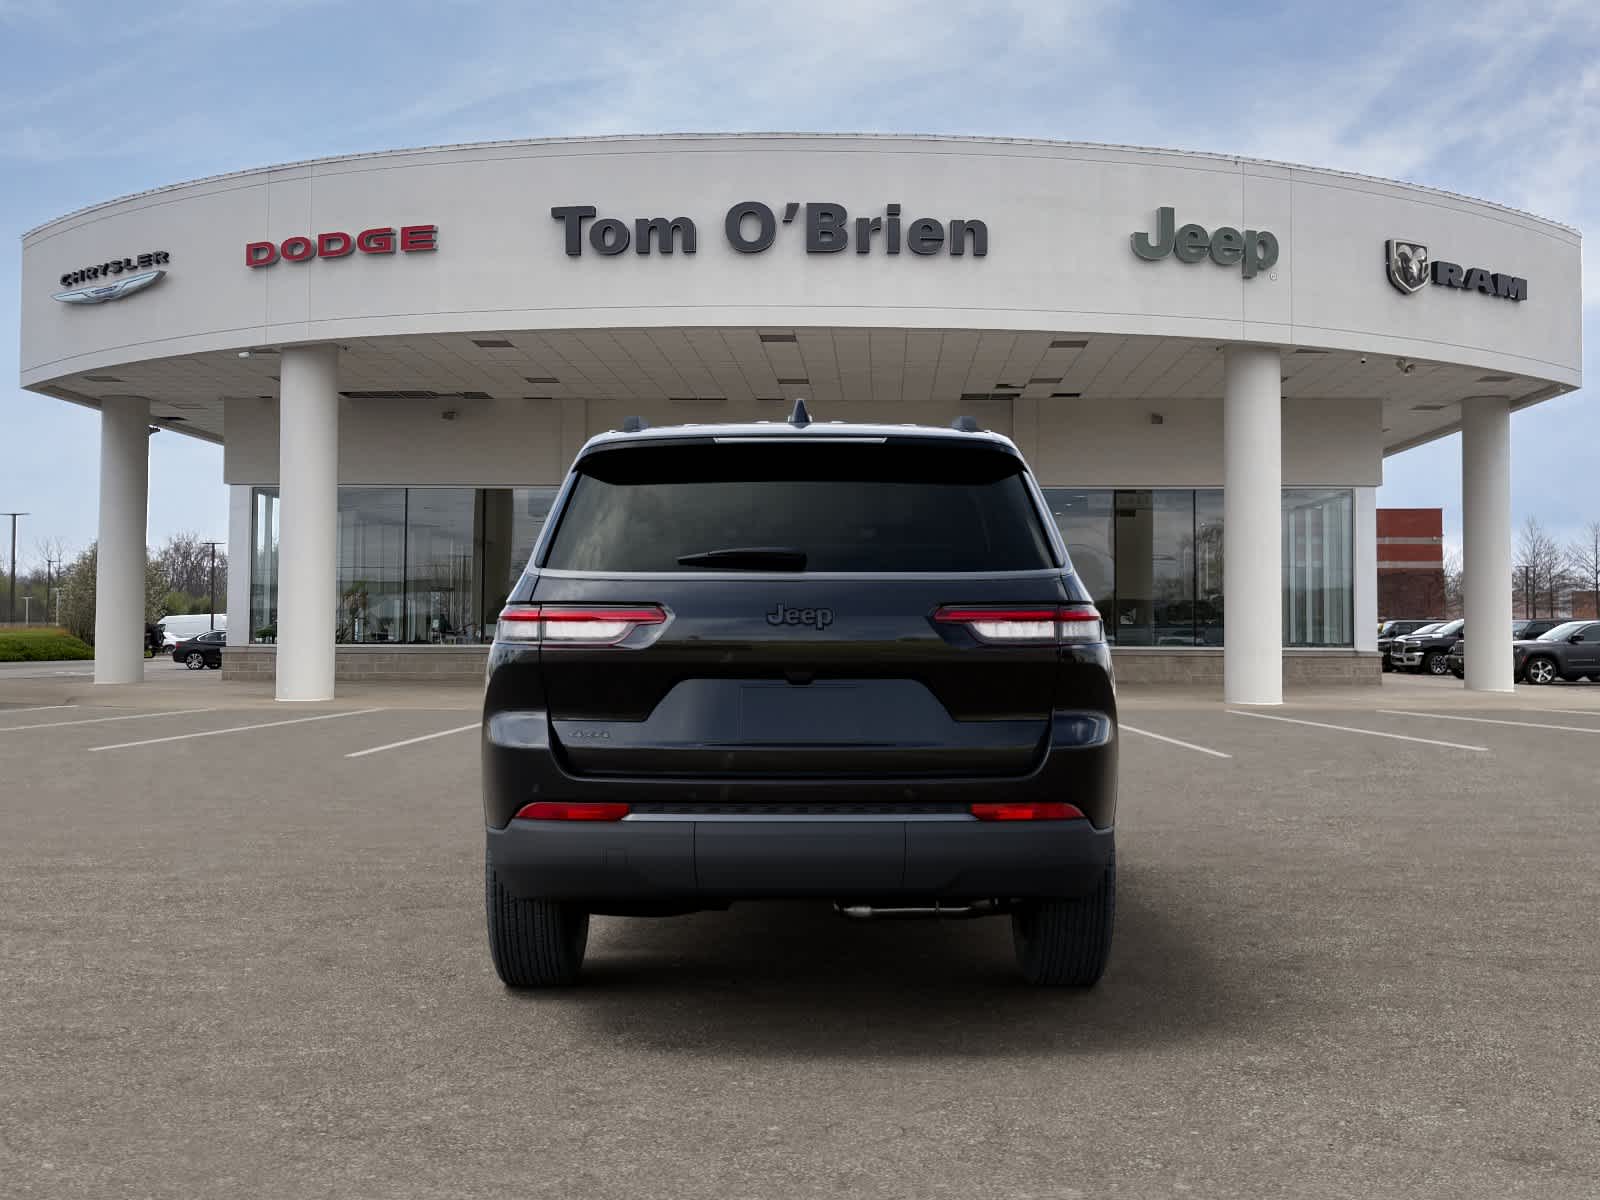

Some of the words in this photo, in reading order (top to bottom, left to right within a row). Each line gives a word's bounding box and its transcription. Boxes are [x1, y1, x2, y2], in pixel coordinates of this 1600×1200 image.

[245, 224, 438, 269] DODGE
[551, 205, 697, 257] Tom
[1130, 206, 1280, 279] Jeep
[60, 250, 170, 287] CHRYSLER
[1430, 260, 1528, 302] RAM
[767, 603, 833, 631] Jeep
